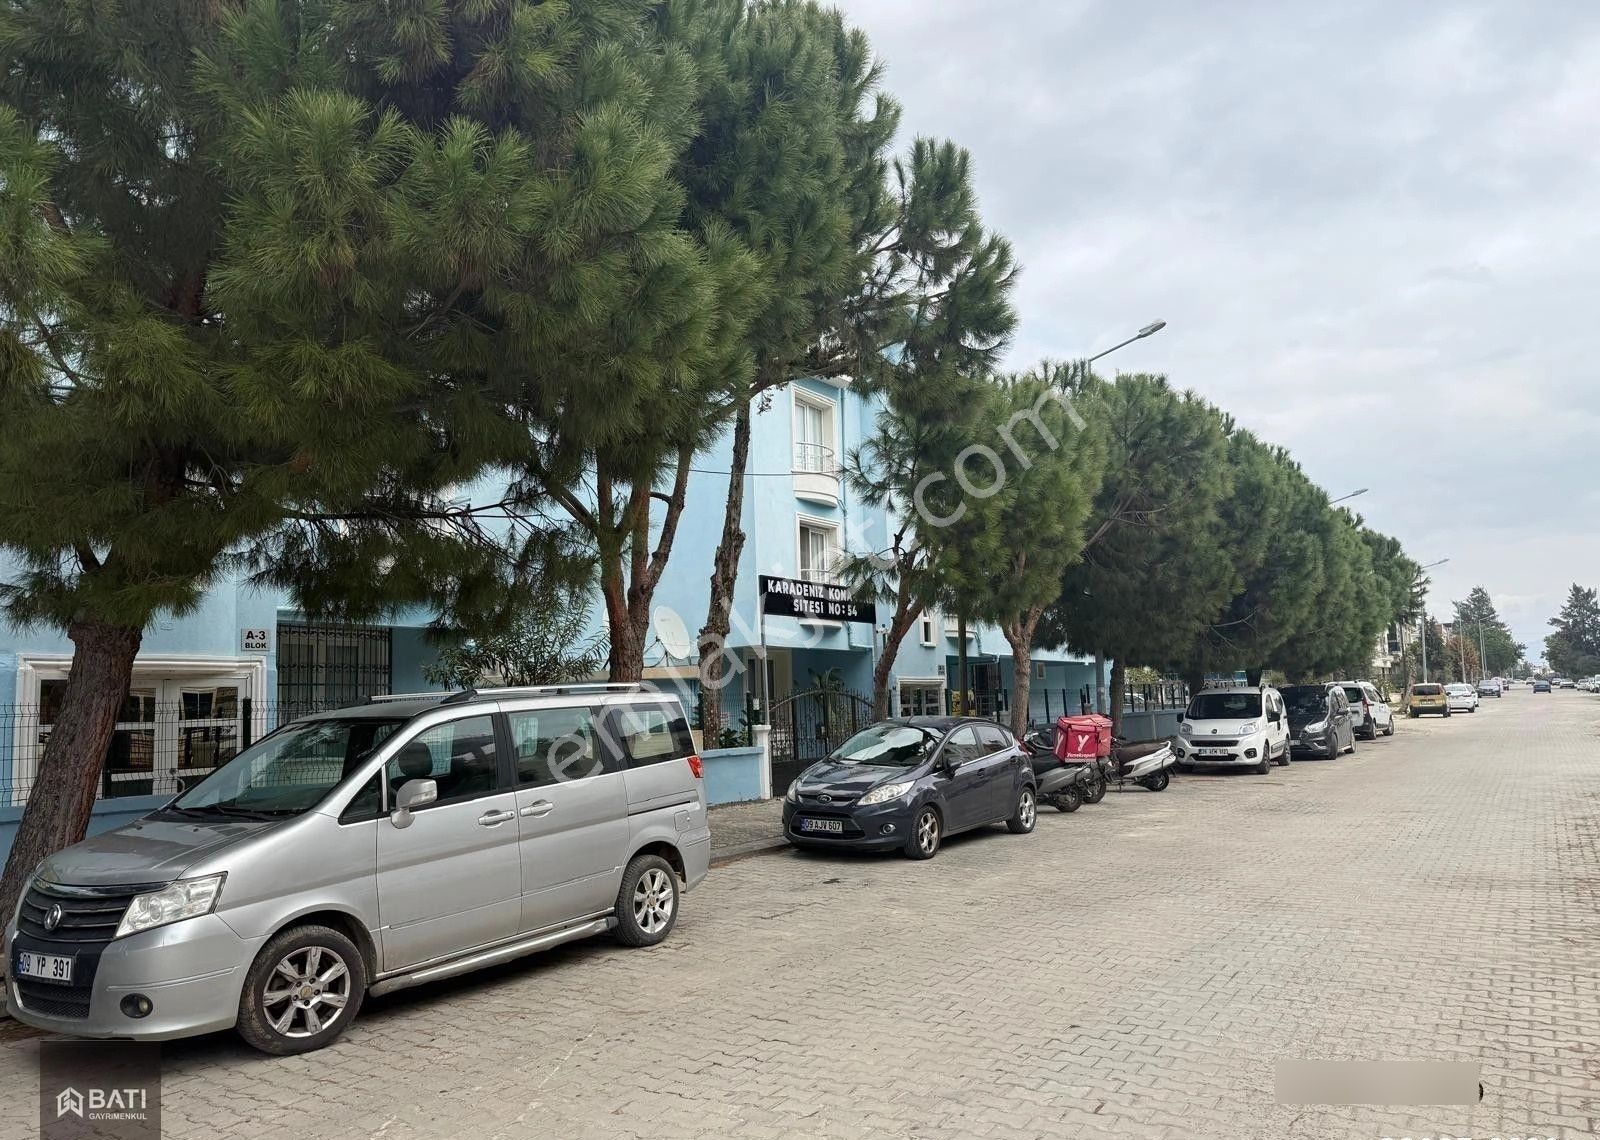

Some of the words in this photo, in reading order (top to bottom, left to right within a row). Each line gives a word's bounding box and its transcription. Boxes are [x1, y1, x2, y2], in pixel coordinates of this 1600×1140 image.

[246, 630, 266, 640] A-3
[828, 820, 841, 831] 607
[22, 953, 31, 973] 09
[52, 957, 70, 979] 391
